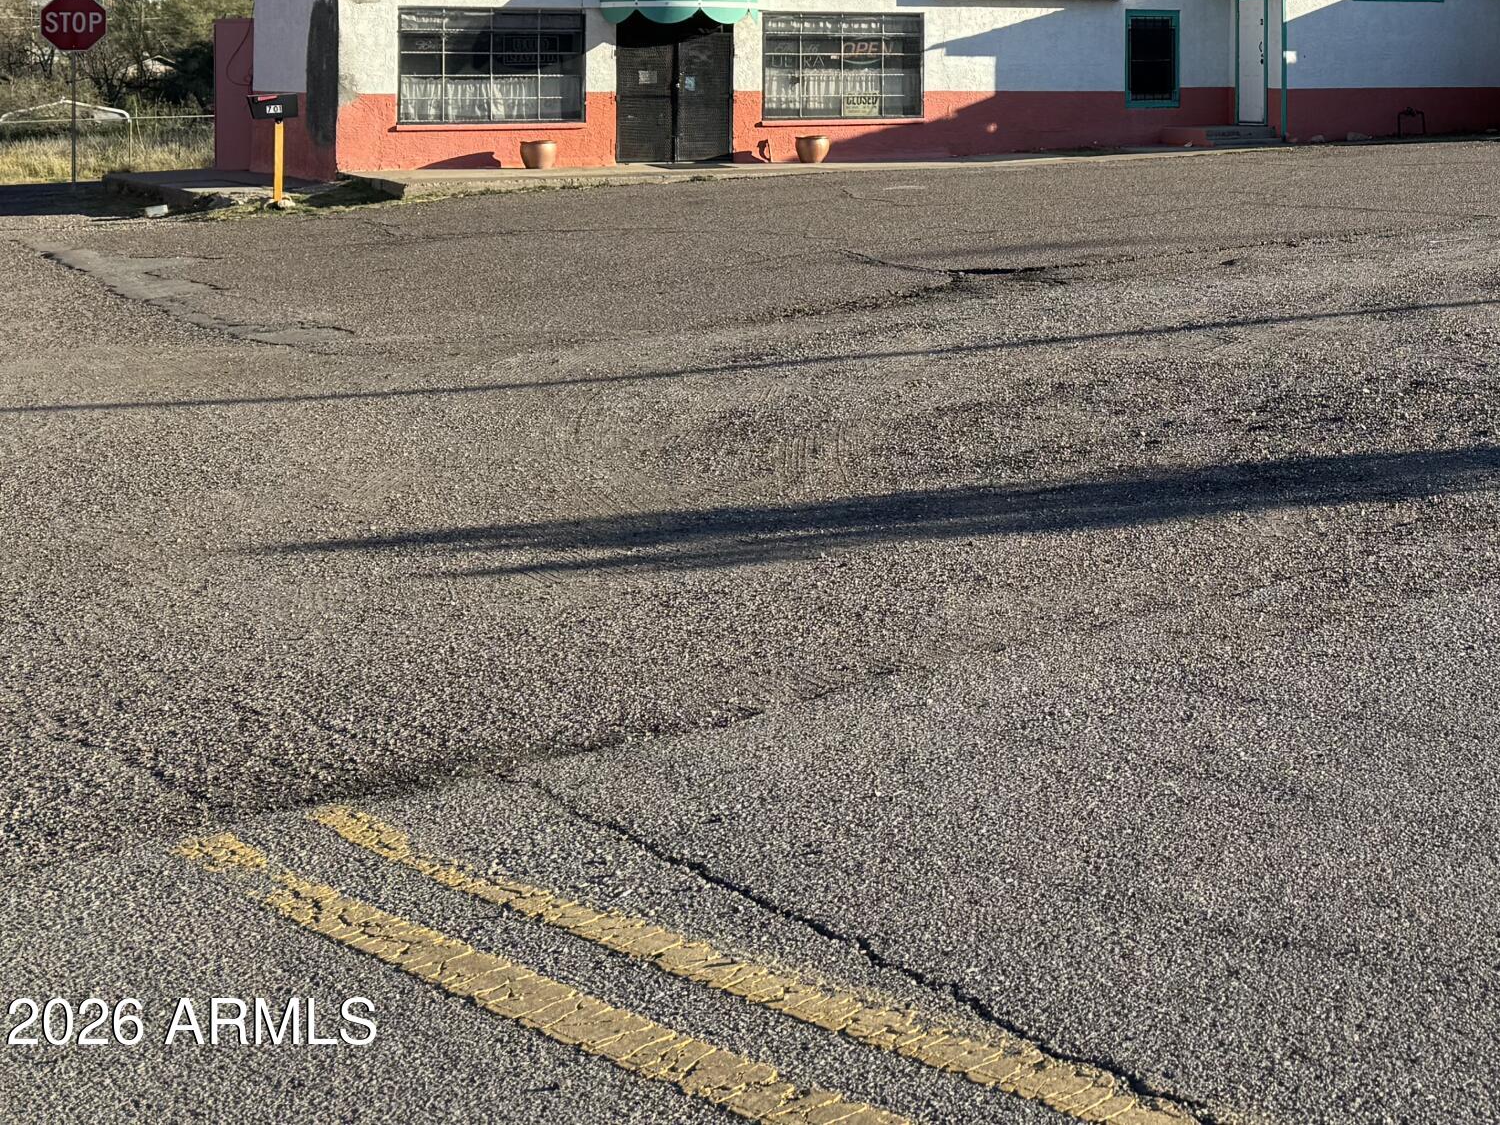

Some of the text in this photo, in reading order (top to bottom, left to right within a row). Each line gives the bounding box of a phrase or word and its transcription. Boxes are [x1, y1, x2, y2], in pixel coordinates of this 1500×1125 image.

[44, 11, 103, 33] STOP
[841, 41, 895, 60] OPEN
[845, 92, 880, 106] CLOSED
